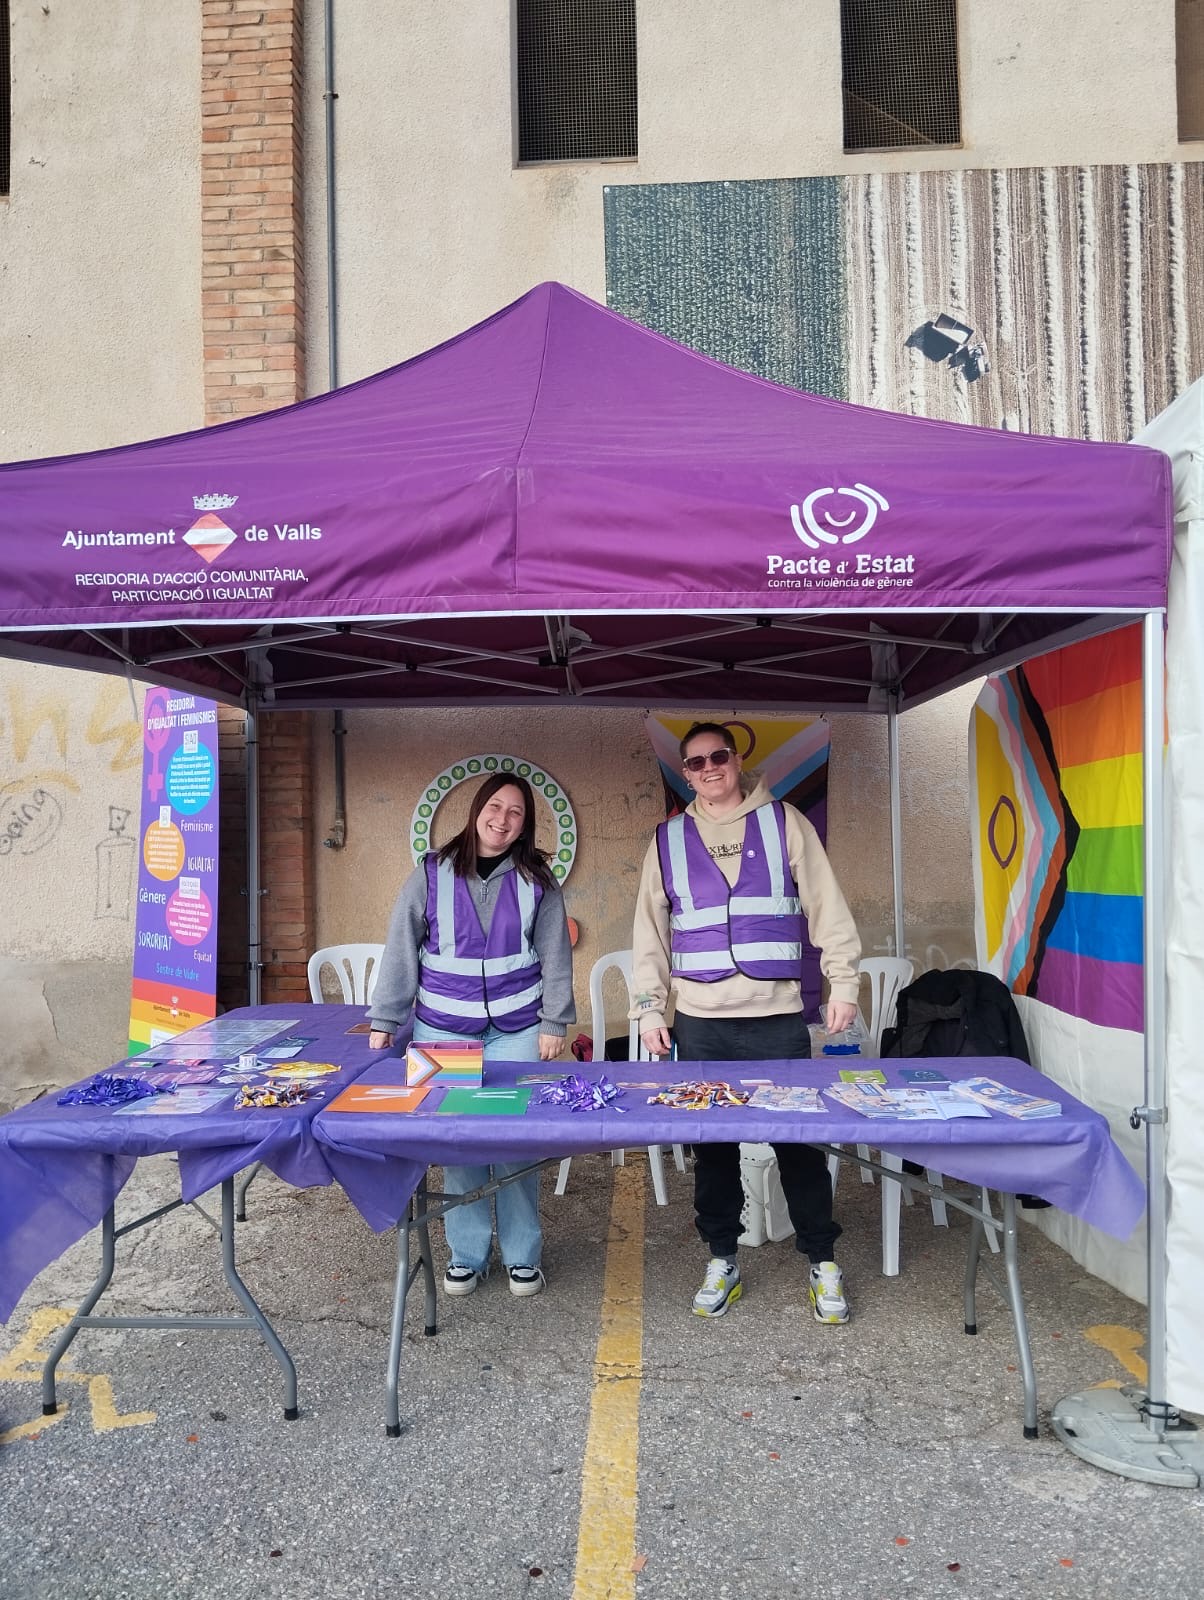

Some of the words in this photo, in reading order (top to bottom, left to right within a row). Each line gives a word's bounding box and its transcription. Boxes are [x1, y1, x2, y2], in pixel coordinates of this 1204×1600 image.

[62, 529, 175, 549] Ajuntament
[244, 525, 269, 541] de
[274, 524, 322, 540] Valls
[767, 555, 831, 575] Pacte
[837, 561, 849, 574] d'
[855, 554, 915, 574] Estat
[75, 573, 150, 586] REGIDORIA
[153, 569, 208, 585] D'ACCIÓ
[210, 566, 309, 583] COMUNITÀRIA,
[768, 579, 801, 588] contra
[803, 578, 813, 588] la
[815, 577, 859, 588] violència
[862, 577, 875, 587] de
[877, 577, 913, 589] gènere
[112, 587, 204, 602] PARTICIPACIÓ
[213, 587, 274, 599] IGUALTAT
[166, 696, 196, 713] REGIDORIA
[147, 714, 177, 730] D'IGUALTAT
[180, 710, 216, 727] FEMINISMES
[180, 820, 213, 833] Feminisme
[187, 856, 215, 873] IGUALTAT
[139, 887, 166, 904] Gènere
[138, 930, 172, 952] SORORITAT
[193, 949, 212, 963] Equitat
[156, 962, 174, 976] Sostre
[174, 967, 183, 977] de
[183, 967, 199, 981] Vidre
